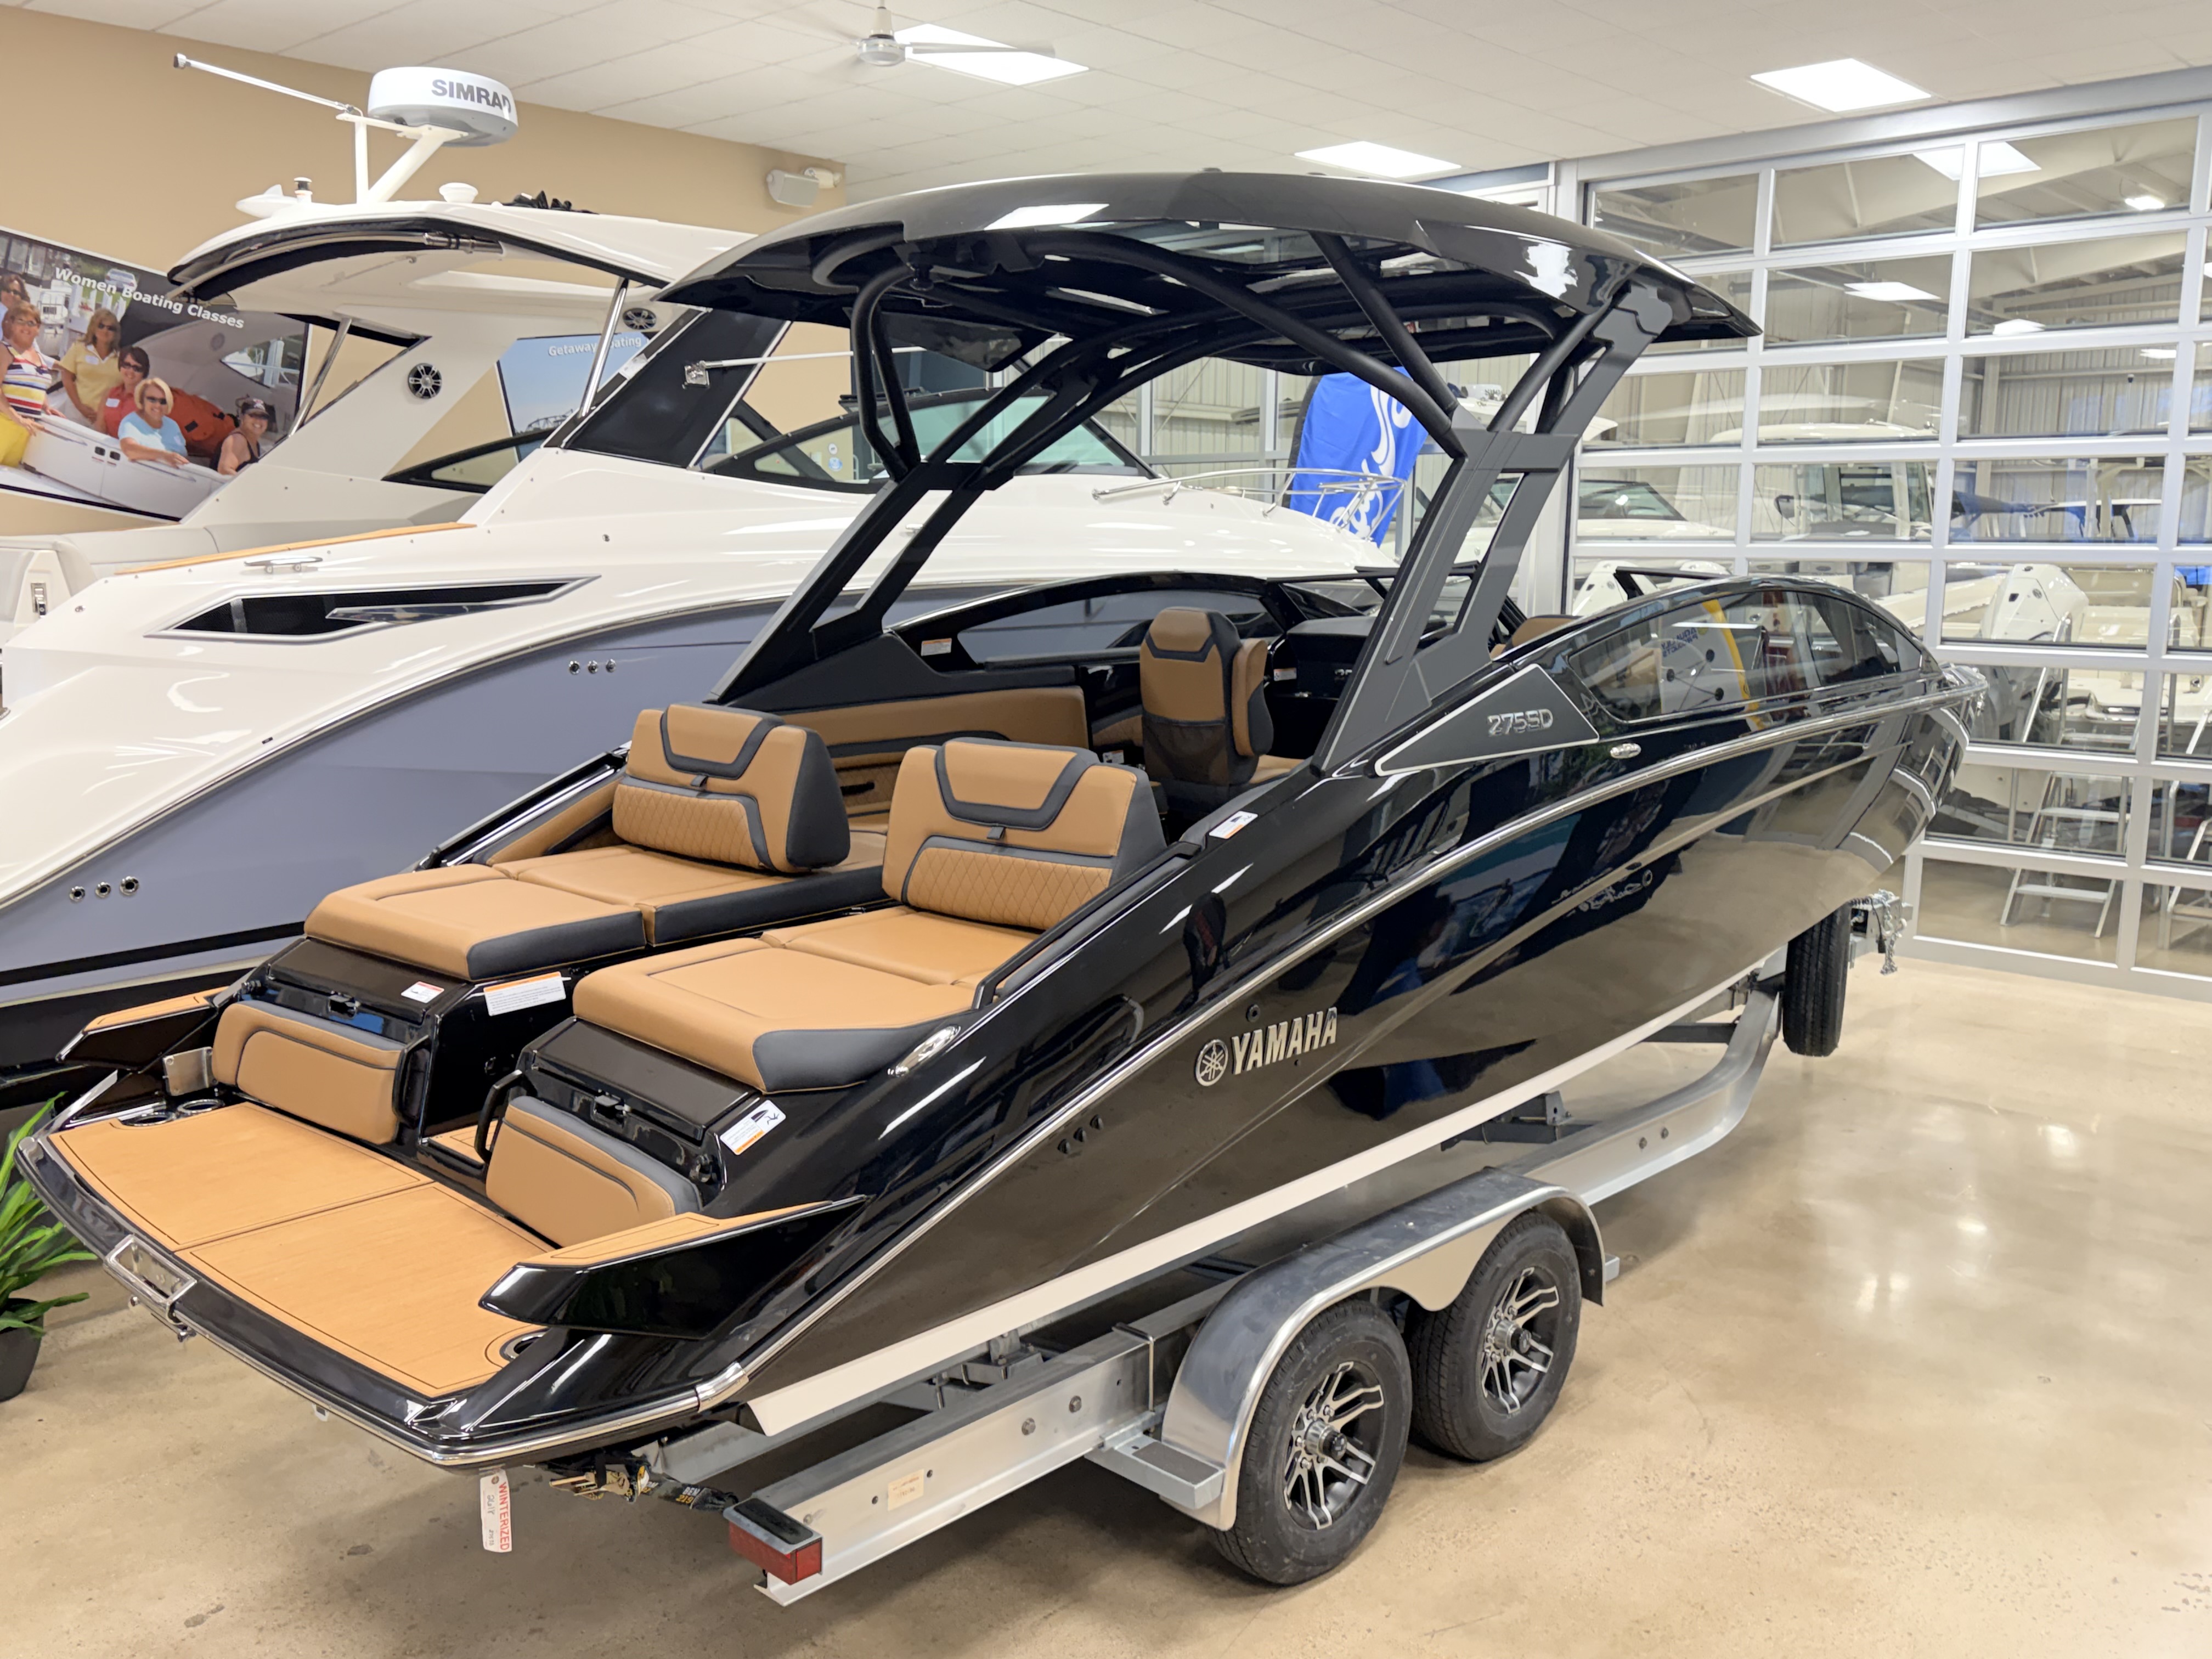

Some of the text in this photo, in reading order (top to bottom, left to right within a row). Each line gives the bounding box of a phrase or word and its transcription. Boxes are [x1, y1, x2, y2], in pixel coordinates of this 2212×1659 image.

[431, 79, 511, 113] SIMRAD
[55, 267, 245, 329] Women Boating Classes
[549, 336, 641, 356] Getaway oating
[1487, 708, 1553, 736] 275SD
[1232, 1007, 1338, 1075] YAMAHA
[498, 1481, 510, 1550] WINTERIZED
